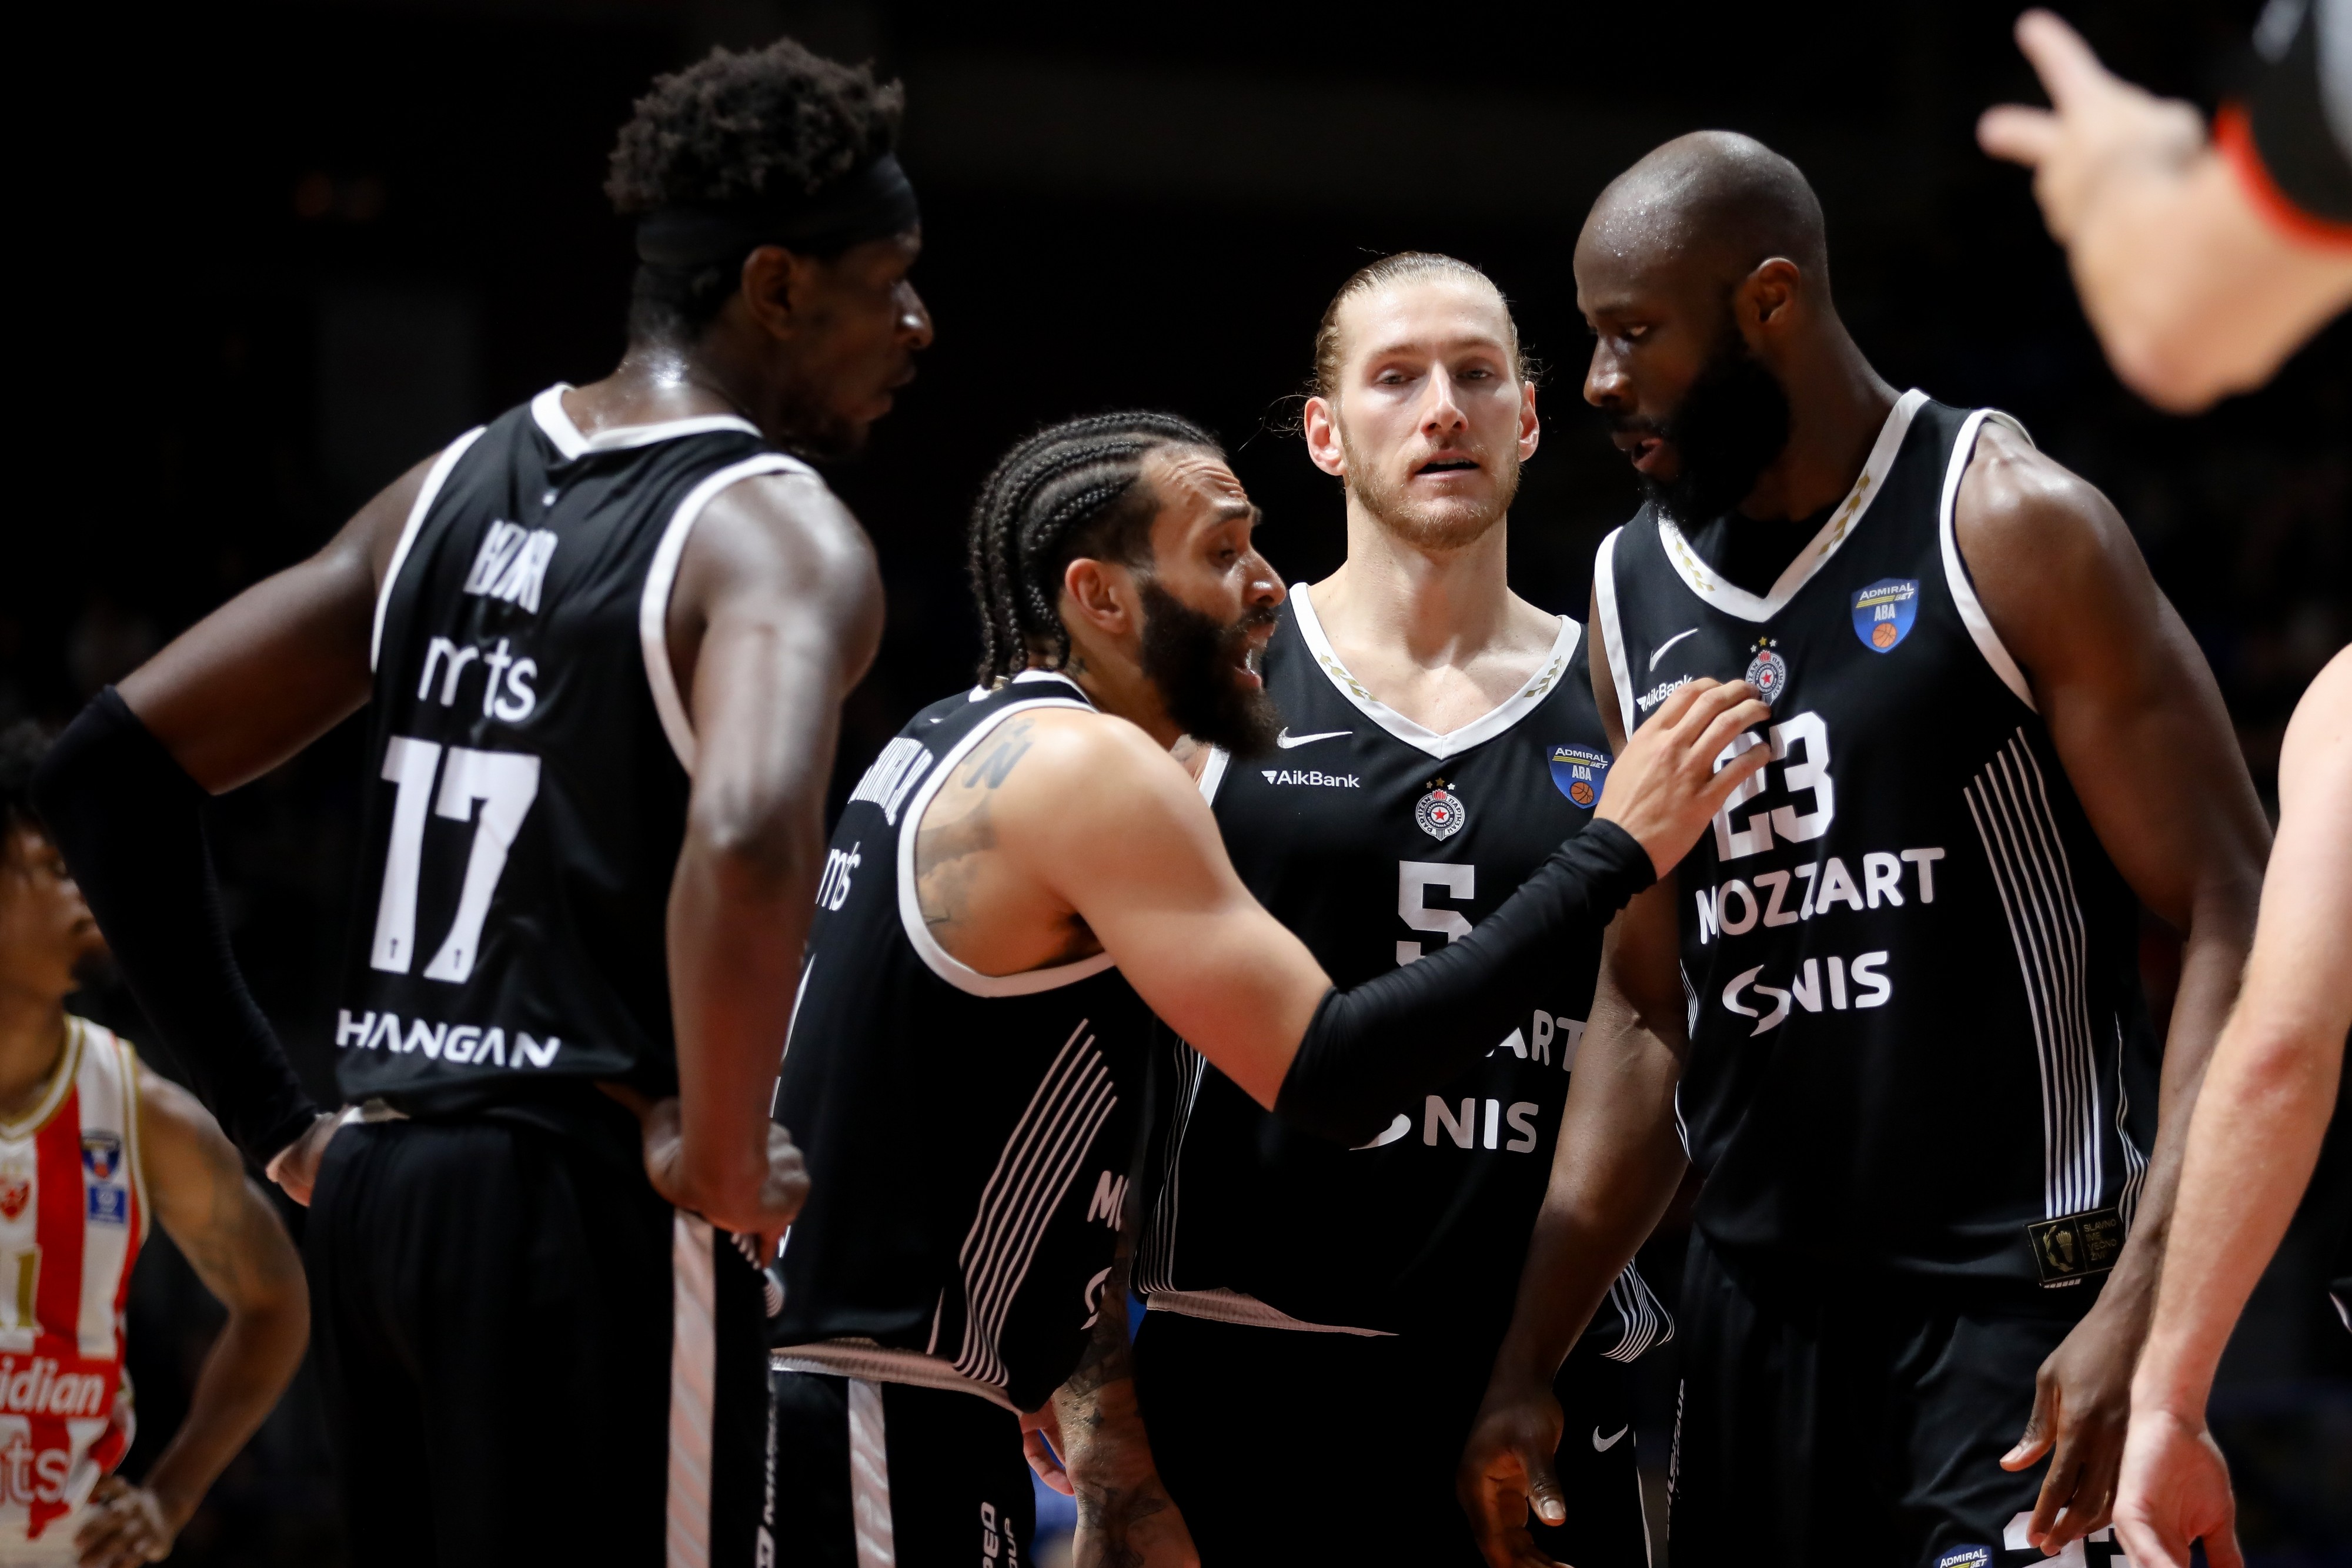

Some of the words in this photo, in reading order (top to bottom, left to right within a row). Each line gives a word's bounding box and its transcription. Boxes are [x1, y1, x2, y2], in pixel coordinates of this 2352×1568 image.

[1859, 583, 1915, 601] ADMIRAL
[1874, 604, 1896, 621] ABA
[1894, 591, 1914, 601] BET
[417, 637, 538, 723] mts
[1276, 770, 1361, 788] AikBank
[1555, 747, 1608, 763] ADMIRAL
[1572, 765, 1592, 781] ABA
[1712, 711, 1836, 862] 23
[369, 735, 542, 985] 17
[1395, 860, 1475, 969] 5
[1695, 847, 1947, 945] MOZZART
[1792, 950, 1892, 1012] NIS
[335, 1008, 562, 1069] HANGAN
[1423, 1094, 1539, 1154] NIS
[1939, 1548, 1987, 1568] ADMIRAL
